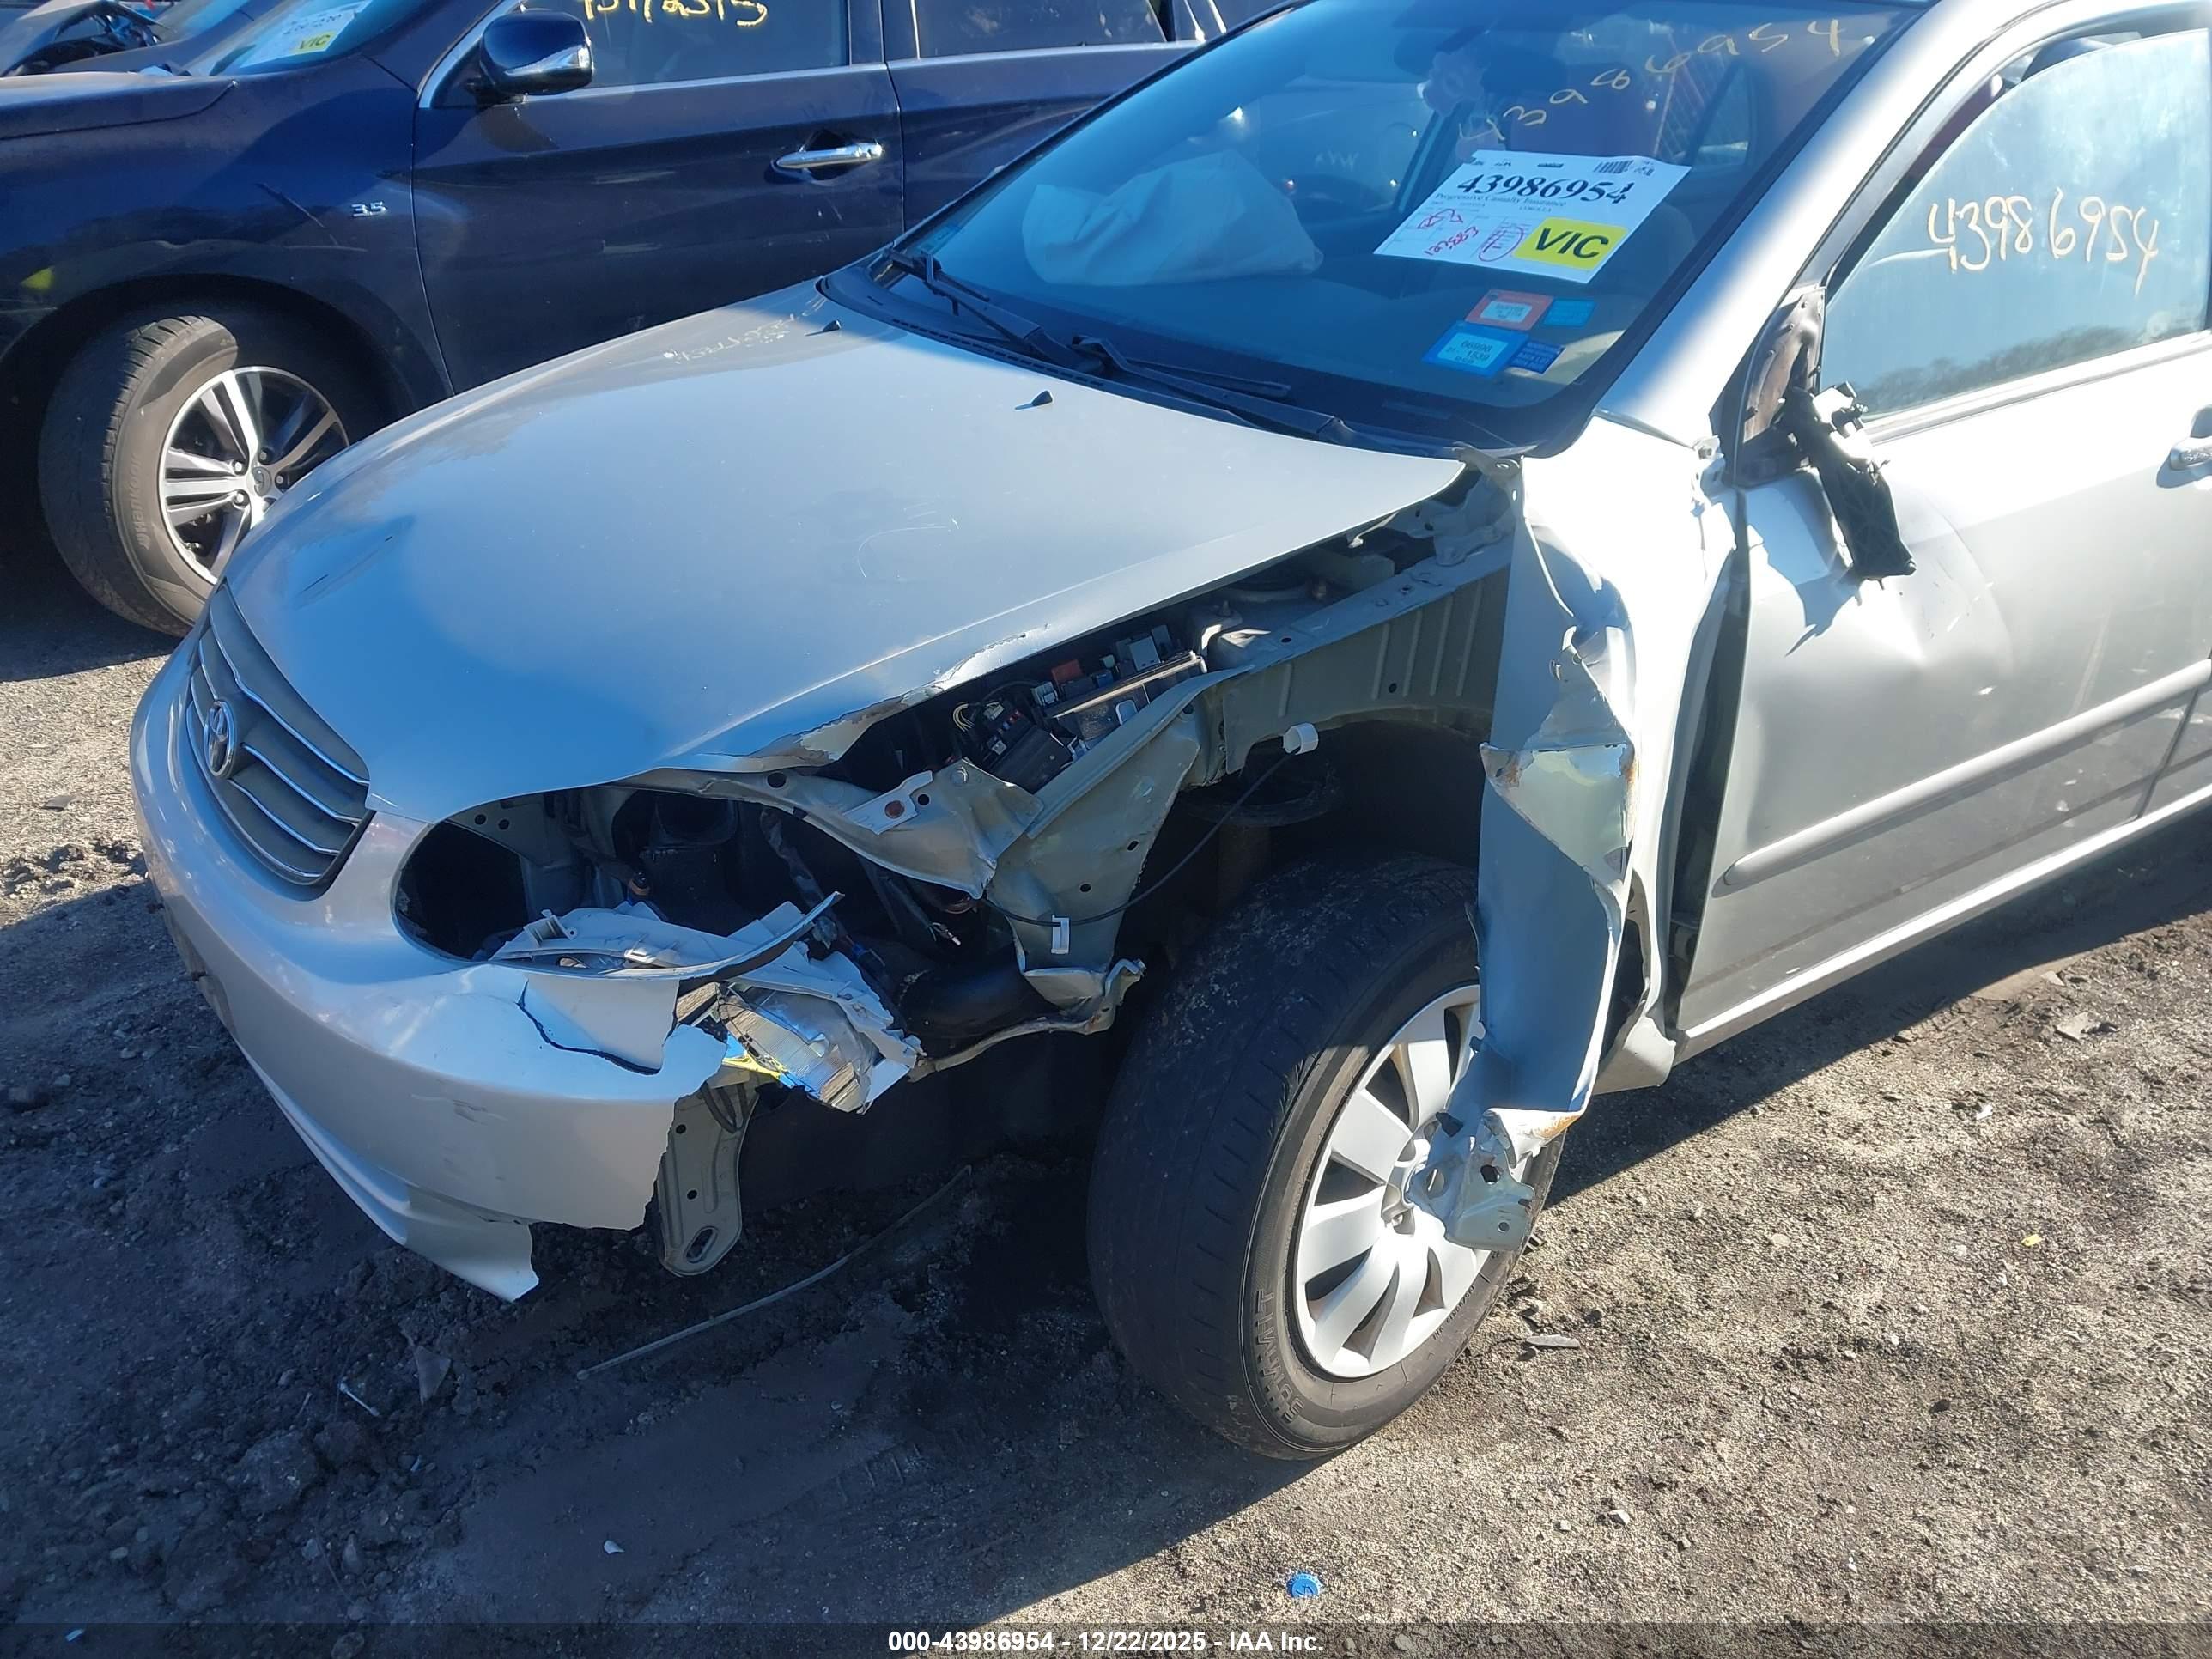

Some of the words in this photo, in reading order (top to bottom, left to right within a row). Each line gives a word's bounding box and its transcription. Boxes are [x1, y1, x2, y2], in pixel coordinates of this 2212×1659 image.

[300, 34, 331, 49] VIC
[1457, 174, 1635, 204] 43986954
[1536, 228, 1609, 258] VIC
[1255, 1290, 1304, 1423] SUMMIT
